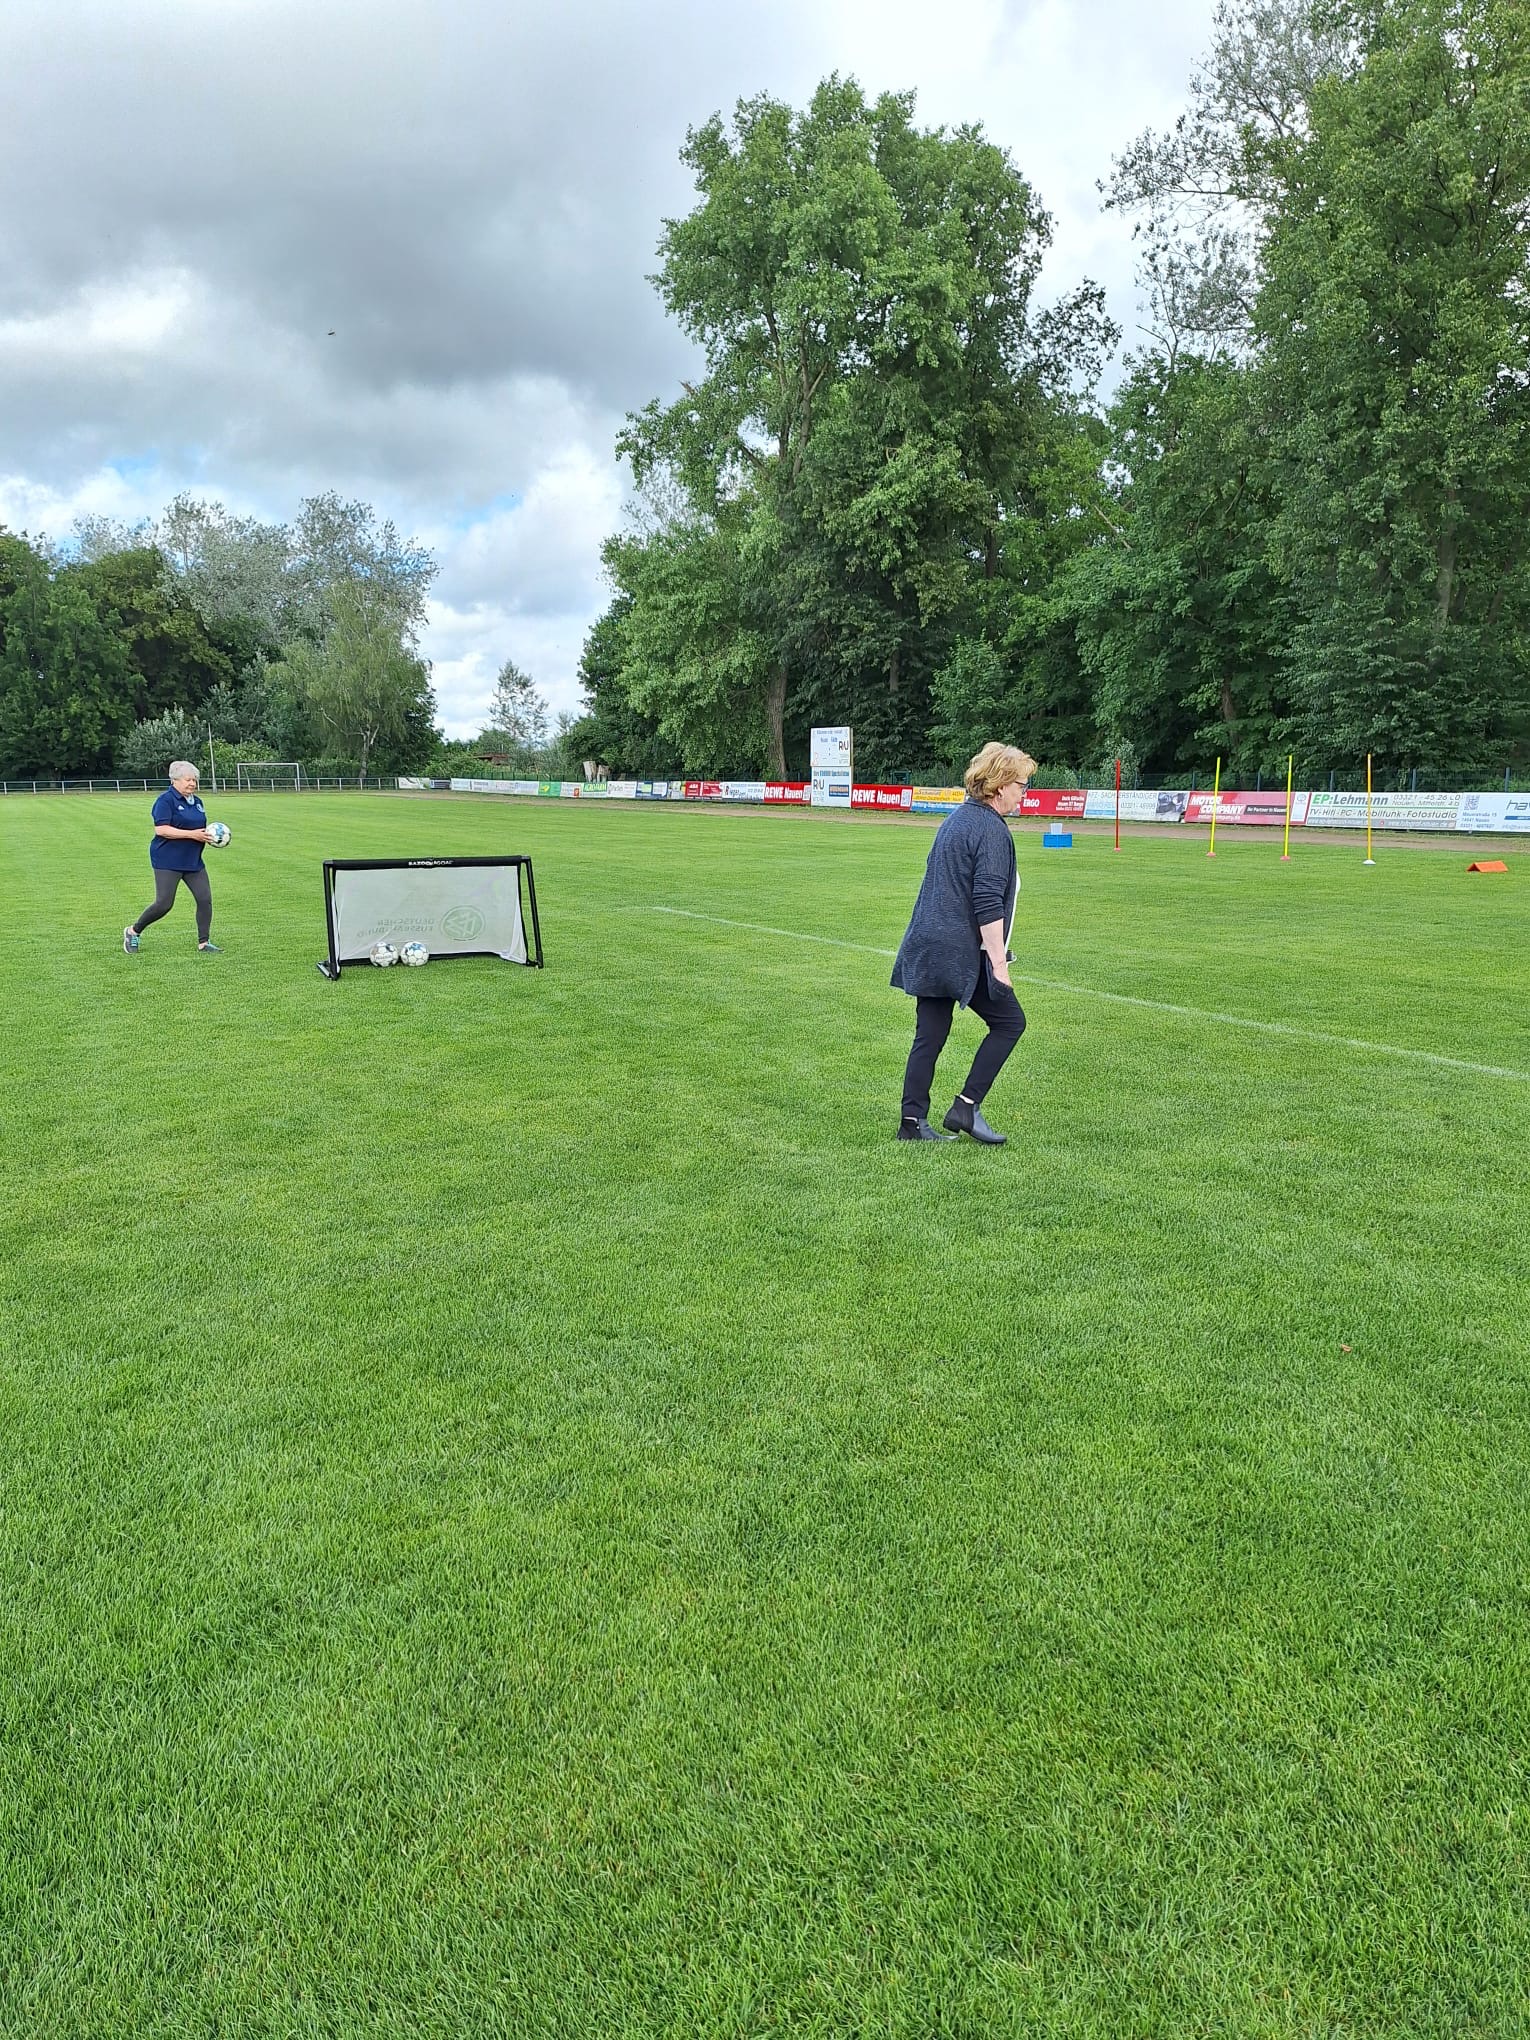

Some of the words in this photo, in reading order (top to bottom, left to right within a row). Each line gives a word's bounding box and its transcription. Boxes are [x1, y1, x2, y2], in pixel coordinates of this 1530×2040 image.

[764, 786, 784, 799] REWE
[785, 787, 803, 799] Nauen
[852, 789, 876, 803] REWE
[877, 790, 901, 804] Nauen
[1023, 798, 1040, 808] ERGO
[1191, 796, 1222, 805] MOTOR
[1312, 794, 1389, 806] EP:Lehmann
[1506, 799, 1530, 811] ha
[1200, 805, 1243, 814] COMPANY
